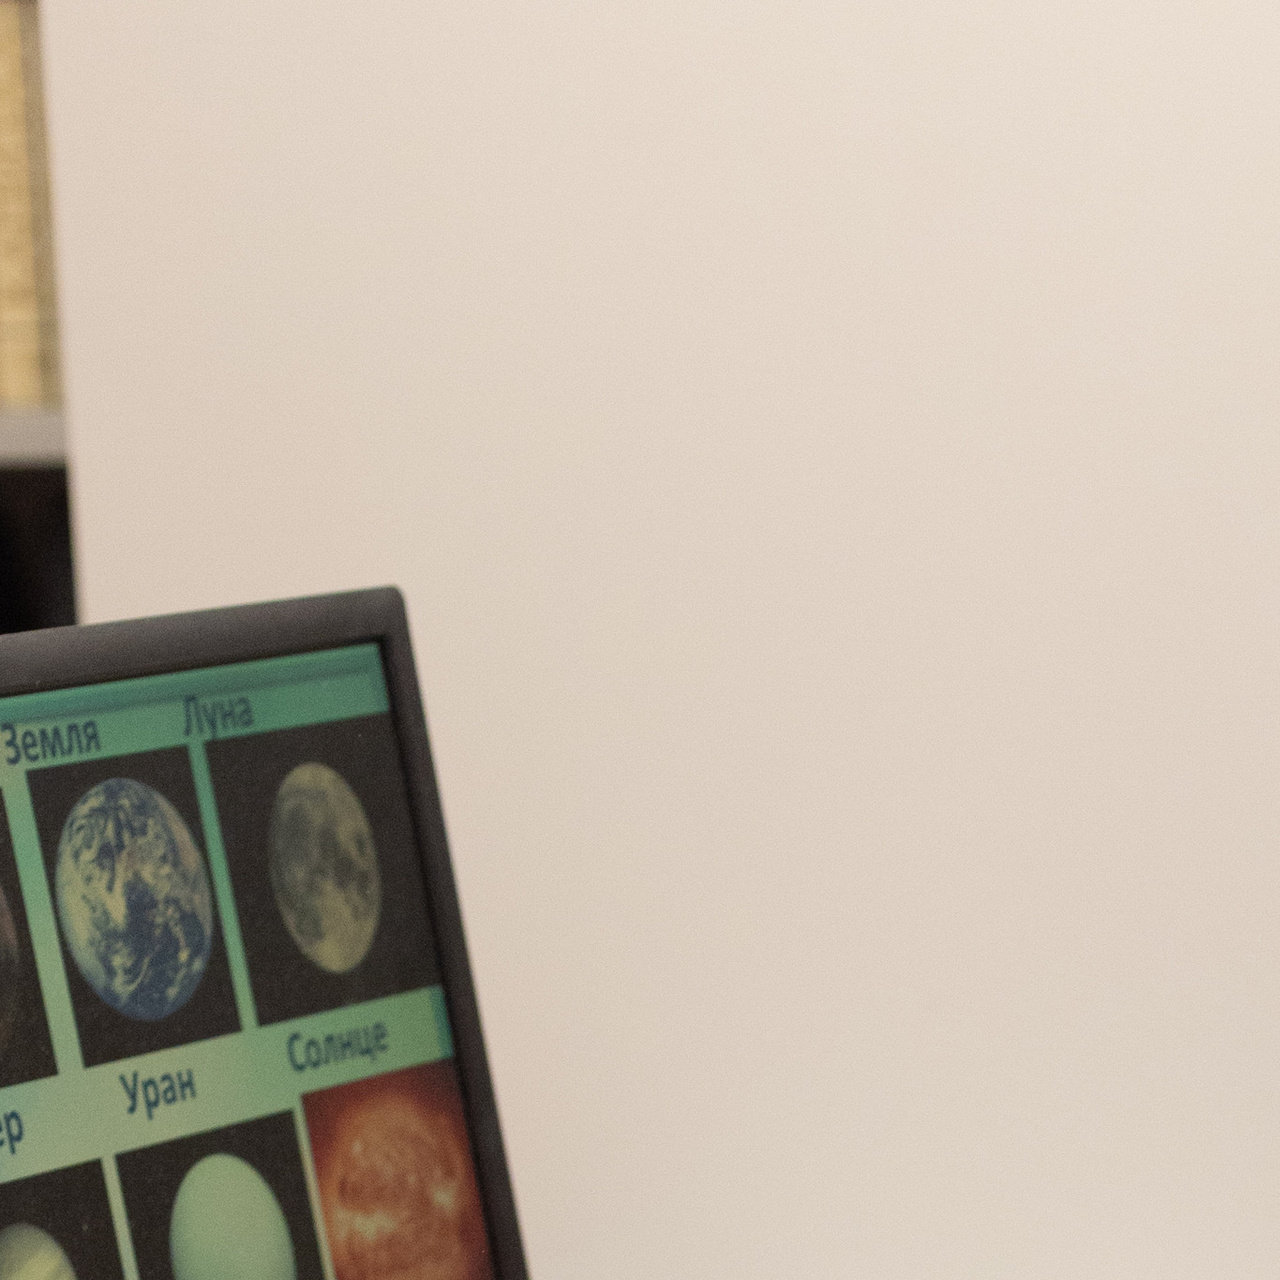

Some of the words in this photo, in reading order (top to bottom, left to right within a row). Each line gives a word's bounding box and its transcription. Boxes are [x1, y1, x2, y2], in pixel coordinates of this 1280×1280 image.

[183, 695, 254, 738] Луна
[1, 719, 101, 766] Земля
[286, 1021, 389, 1072] Солнце
[119, 1068, 197, 1121] Уран
